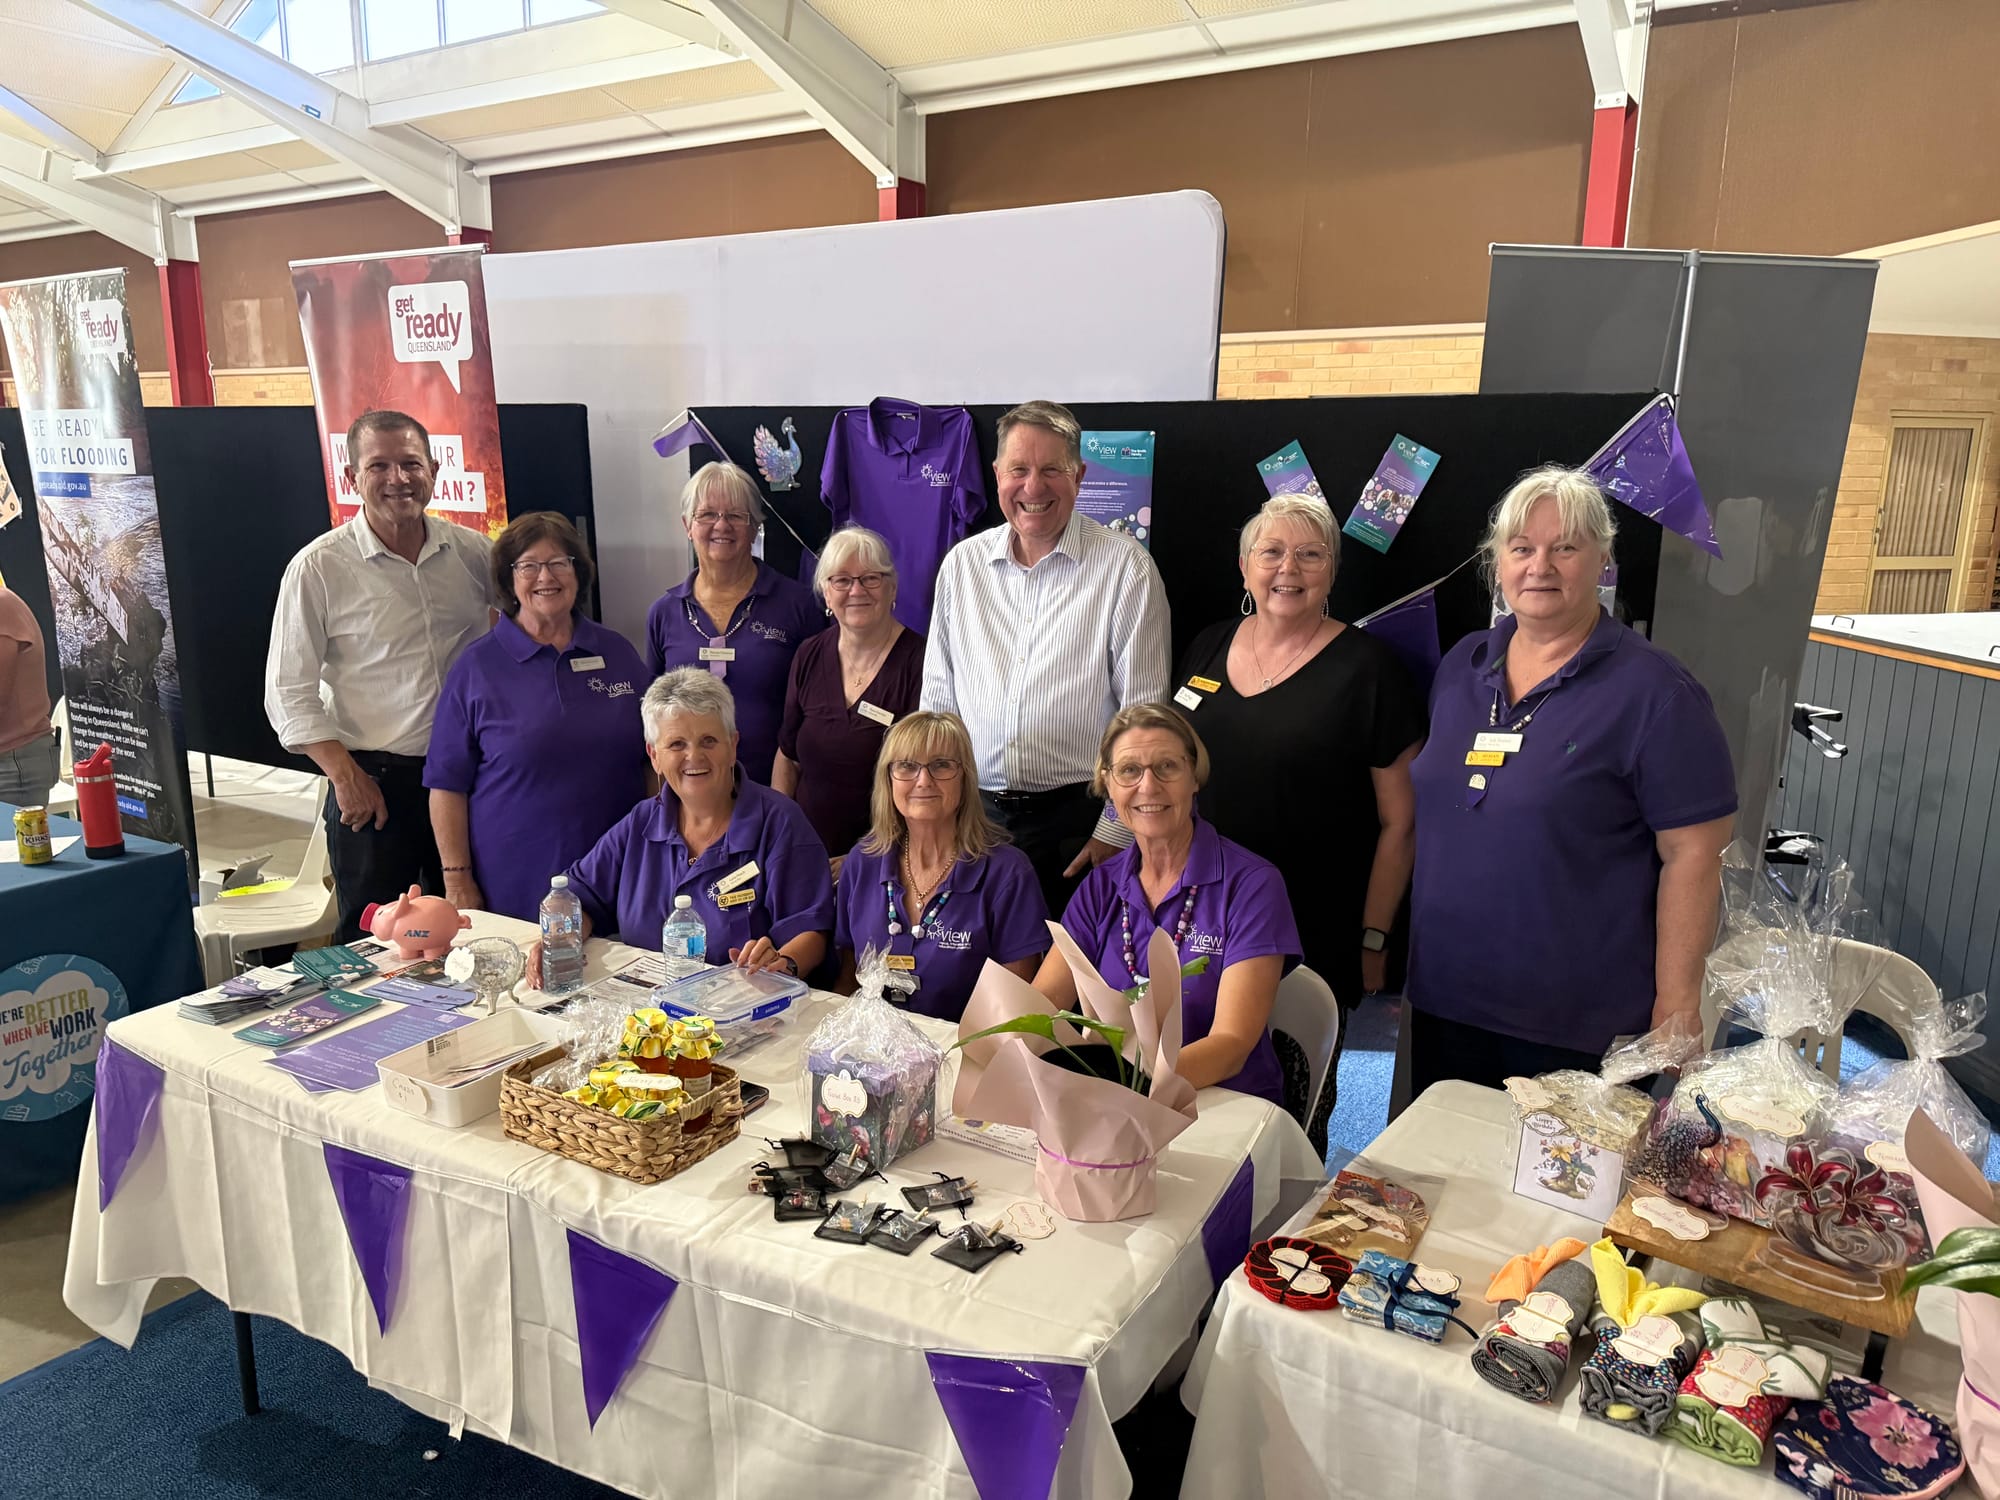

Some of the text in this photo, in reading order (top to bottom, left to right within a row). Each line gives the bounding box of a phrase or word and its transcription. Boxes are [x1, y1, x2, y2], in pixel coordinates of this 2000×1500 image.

[395, 294, 414, 318] get
[80, 308, 91, 324] get
[406, 302, 462, 347] ready
[86, 313, 118, 343] ready
[408, 341, 452, 354] QUEENSLAND
[57, 418, 98, 437] READY
[35, 447, 128, 466] FOR FLOODING
[433, 446, 456, 467] UR
[1098, 444, 1117, 454] view
[930, 470, 951, 482] view
[433, 480, 476, 502] LAN?
[765, 626, 786, 638] view
[604, 680, 631, 694] view
[88, 703, 102, 714] always
[404, 929, 431, 938] ANZ
[941, 928, 971, 943] view
[1194, 931, 1222, 948] view
[24, 989, 90, 1025] BETTER
[3, 1006, 97, 1046] WHEN WE WORK
[2, 1030, 98, 1089] Together
